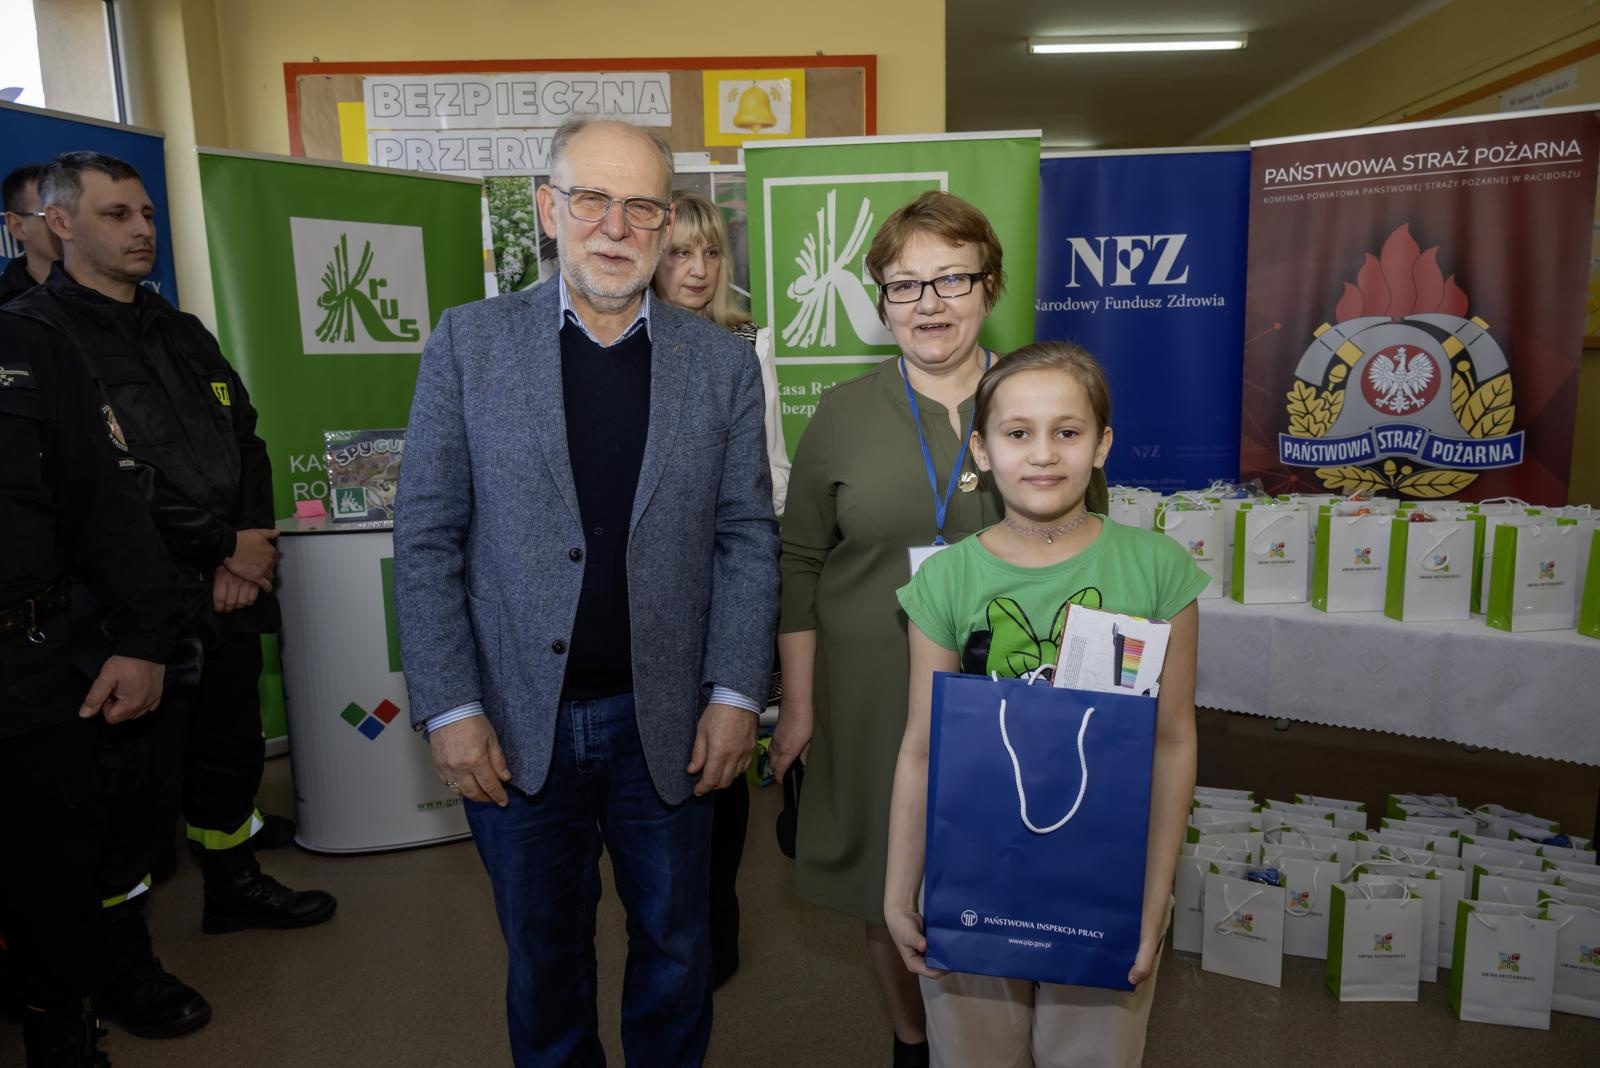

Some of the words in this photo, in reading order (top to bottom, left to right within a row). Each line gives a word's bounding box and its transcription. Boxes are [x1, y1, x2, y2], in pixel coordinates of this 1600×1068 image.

[372, 80, 671, 118] BEZPIECZNA
[375, 136, 553, 172] PRZERW
[1265, 157, 1396, 184] PAŃSTWOWA
[1402, 145, 1468, 171] STRAŻ
[1475, 139, 1582, 164] POŻARNA
[1264, 192, 1304, 203] KOMENDA
[1307, 188, 1360, 200] POWIATOWA
[1362, 183, 1421, 196] PAŃSTWOWEJ
[1462, 175, 1509, 187] POŻARNEJ
[1512, 175, 1522, 183] W
[1524, 170, 1581, 182] RACIBORZU
[1065, 233, 1189, 288] NFZ
[1104, 295, 1162, 310] Fundusz
[1167, 293, 1225, 308] Zdrowia
[1284, 438, 1371, 462] PAŃSTWOWA
[1378, 430, 1423, 451] STRAŻ
[1432, 440, 1514, 464] POŻARNA
[984, 916, 1035, 929] PAŃSTWOWA
[1036, 922, 1077, 936] INSPEKCJA
[1078, 928, 1105, 939] PRACY
